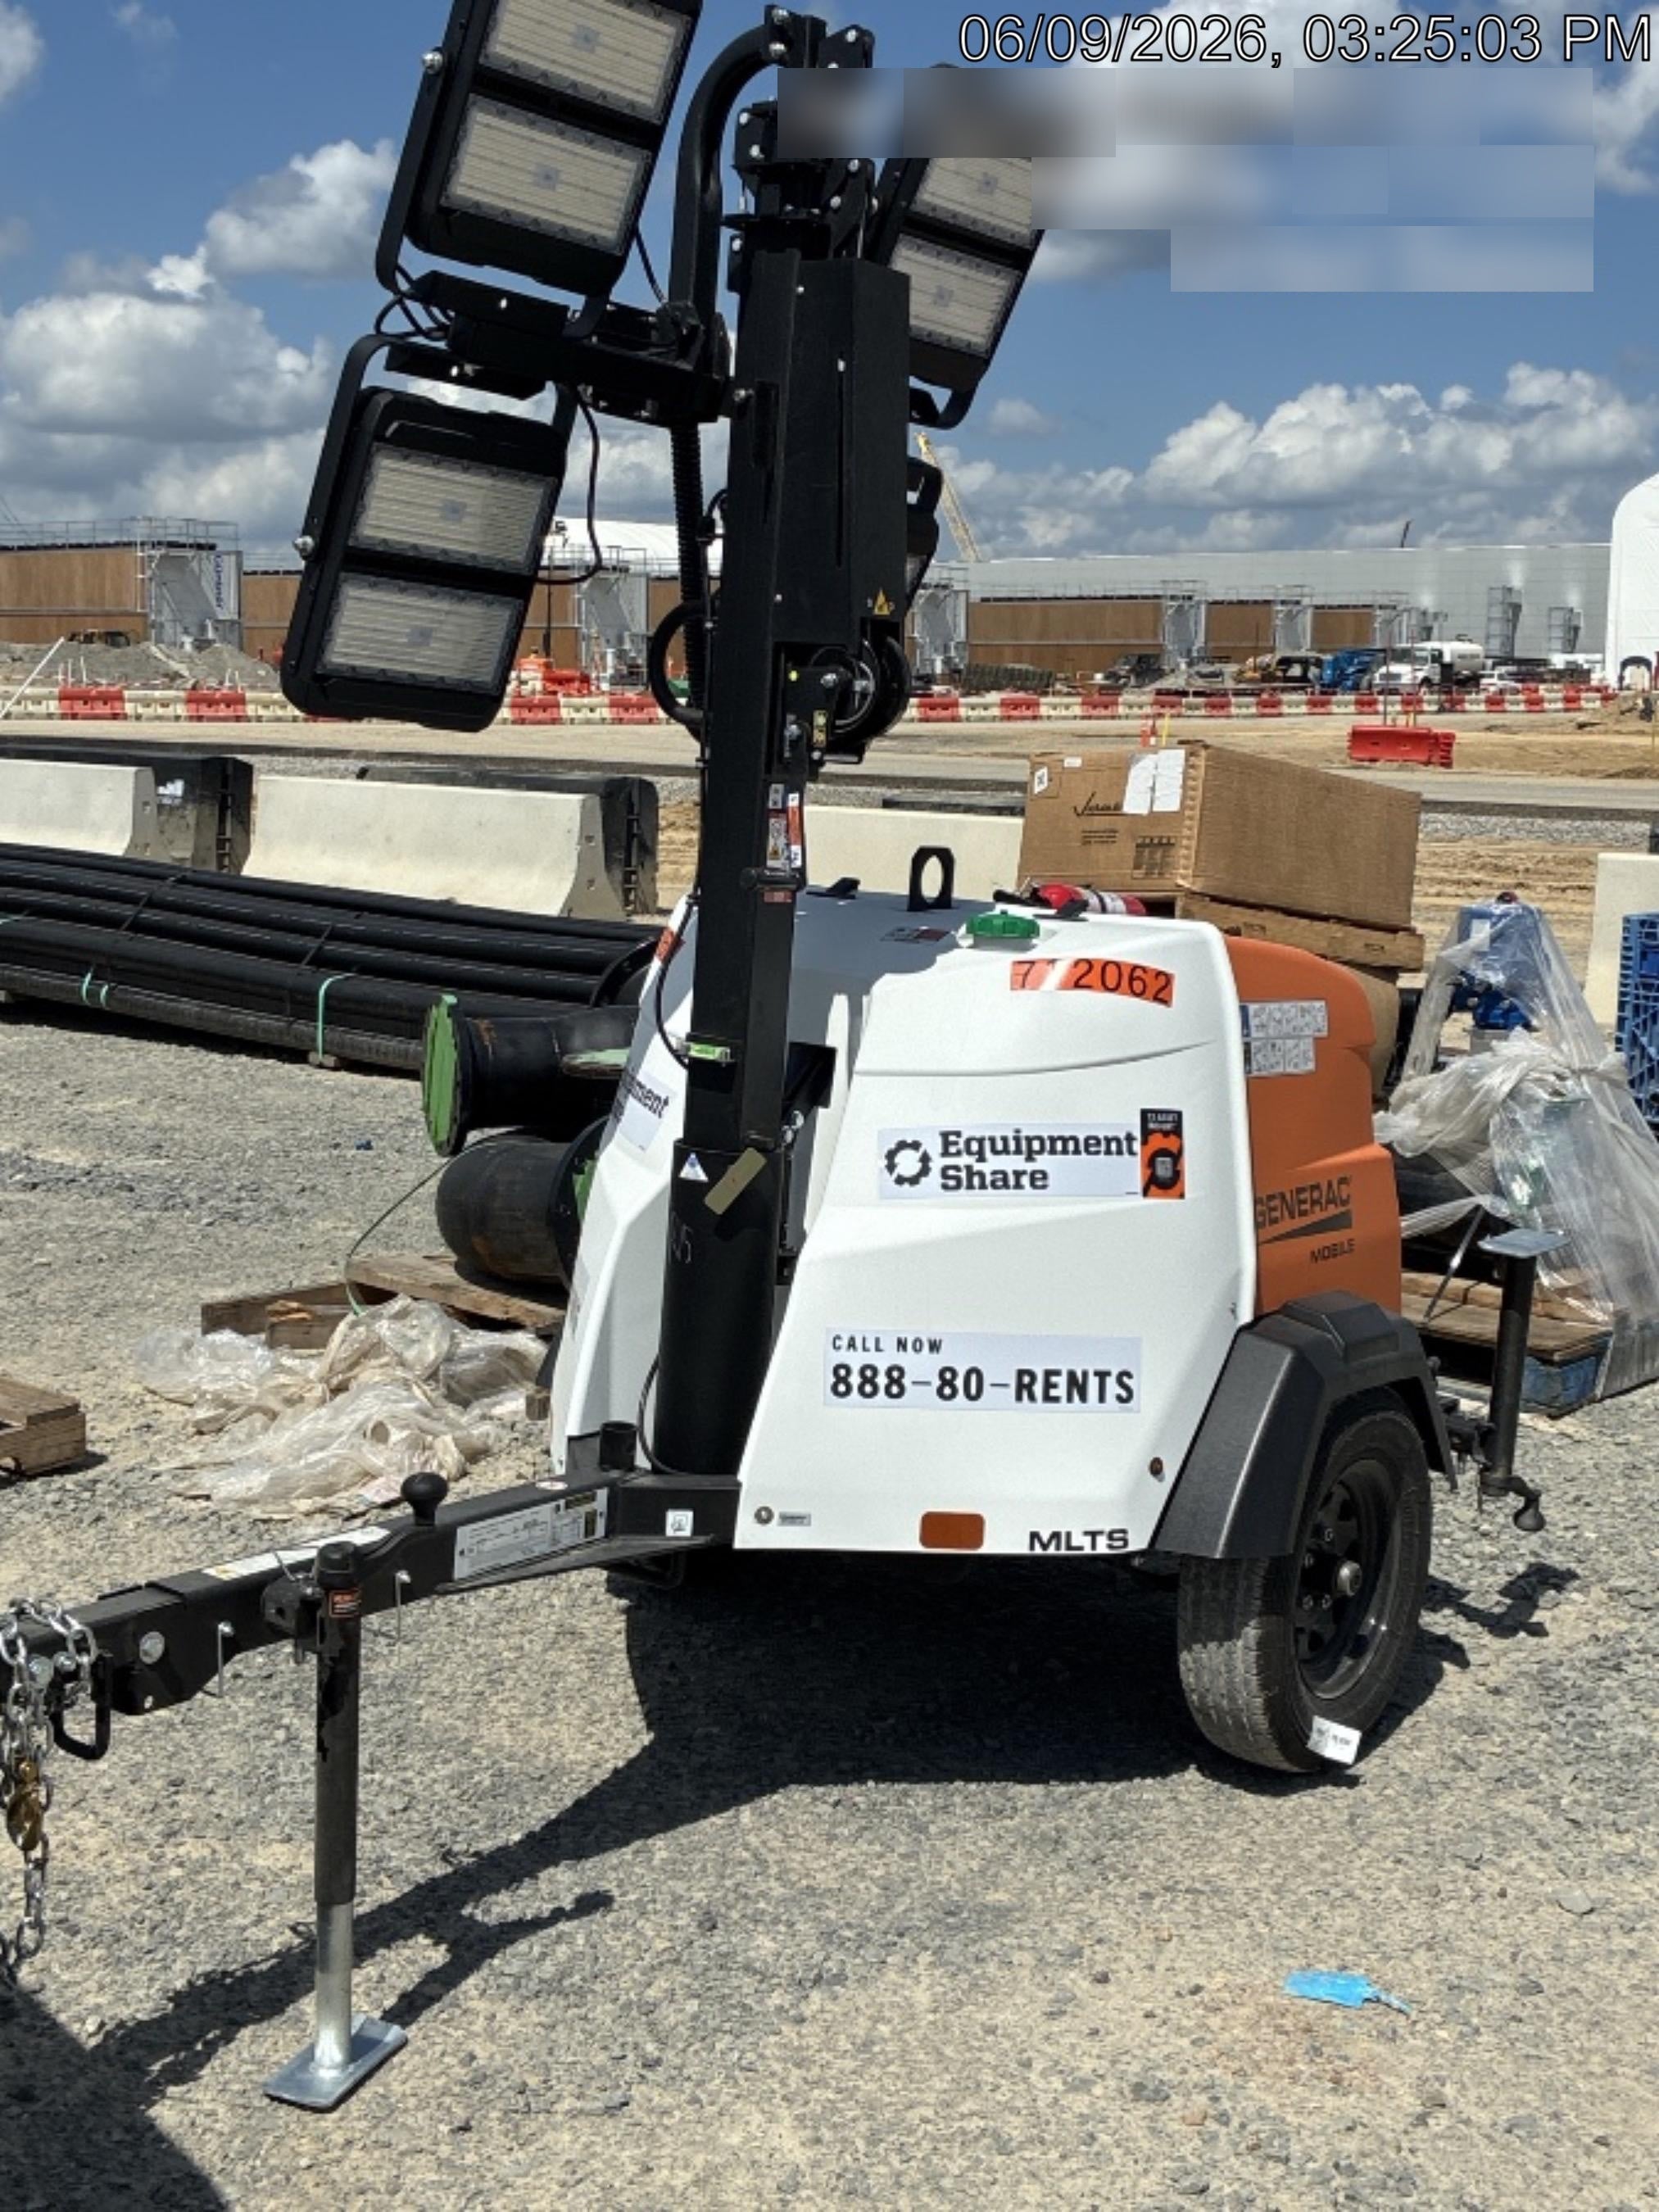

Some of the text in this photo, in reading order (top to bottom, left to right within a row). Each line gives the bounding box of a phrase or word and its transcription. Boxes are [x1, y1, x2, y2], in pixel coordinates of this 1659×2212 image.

[939, 1127, 1138, 1163] Equipment
[939, 1164, 1049, 1191] Share
[1255, 1175, 1352, 1230] GENERAC
[832, 1334, 943, 1355] CALL NOW
[830, 1362, 1135, 1404] 888-80-RENTS
[1029, 1527, 1130, 1552] MLTS
